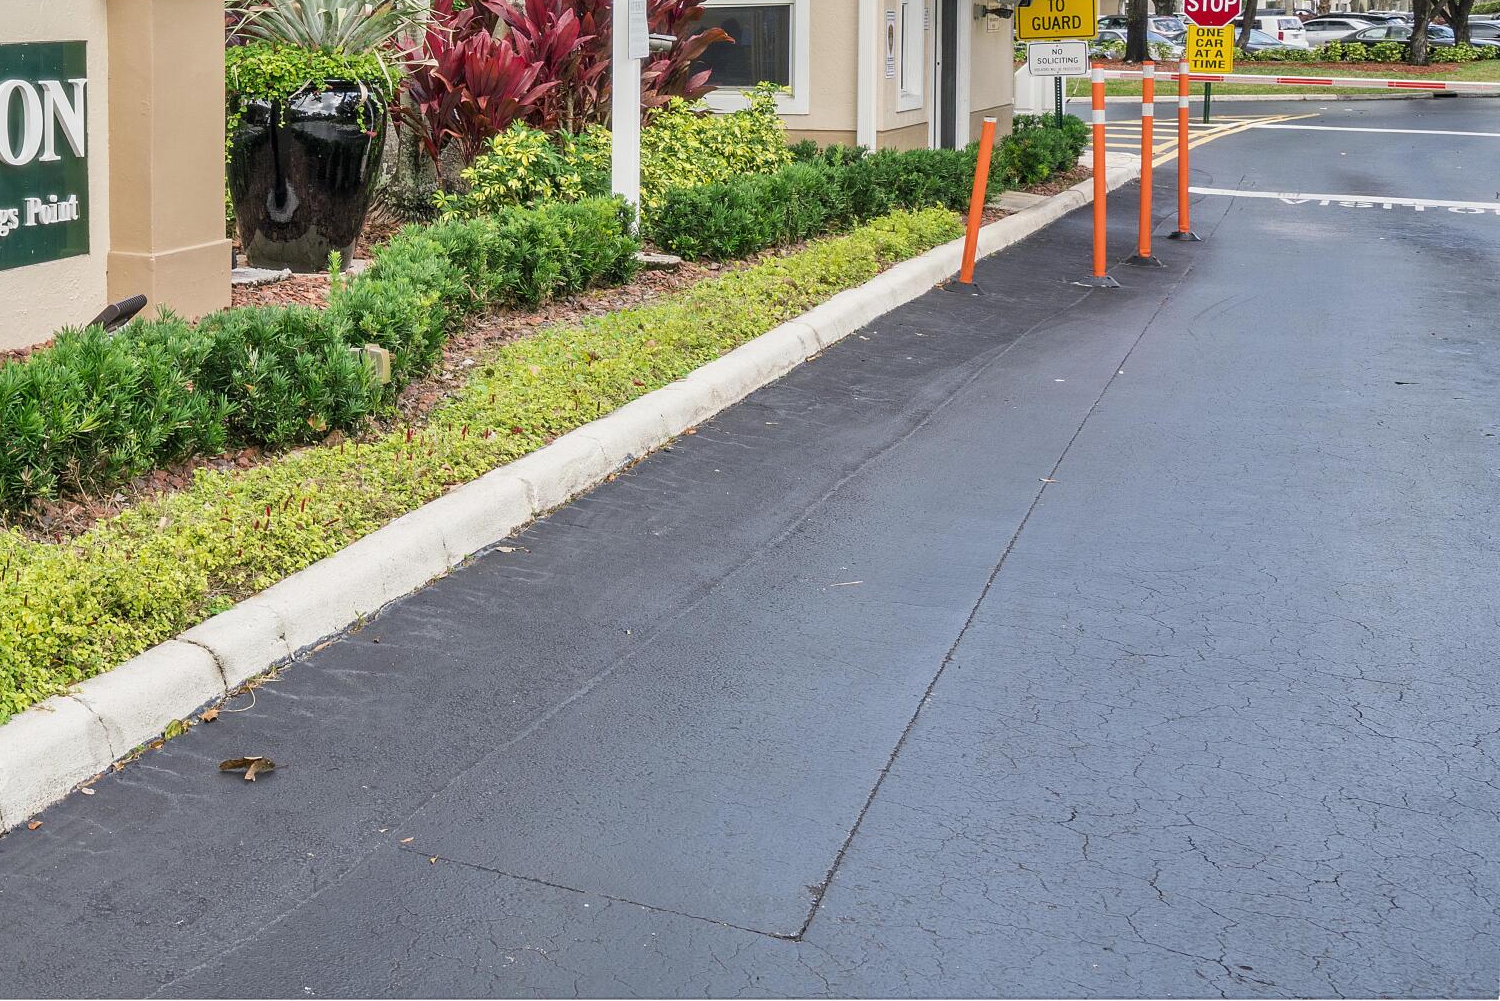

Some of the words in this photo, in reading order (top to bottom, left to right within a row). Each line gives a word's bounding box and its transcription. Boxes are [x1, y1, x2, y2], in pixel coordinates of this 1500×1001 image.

[1032, 15, 1081, 30] GUARD
[1196, 28, 1225, 37] ONE
[1195, 38, 1223, 48] CAR
[1194, 49, 1211, 58] AT
[1215, 49, 1224, 58] A
[1037, 56, 1079, 65] SOLICITING
[1191, 59, 1226, 69] TIME
[23, 194, 80, 228] Point
